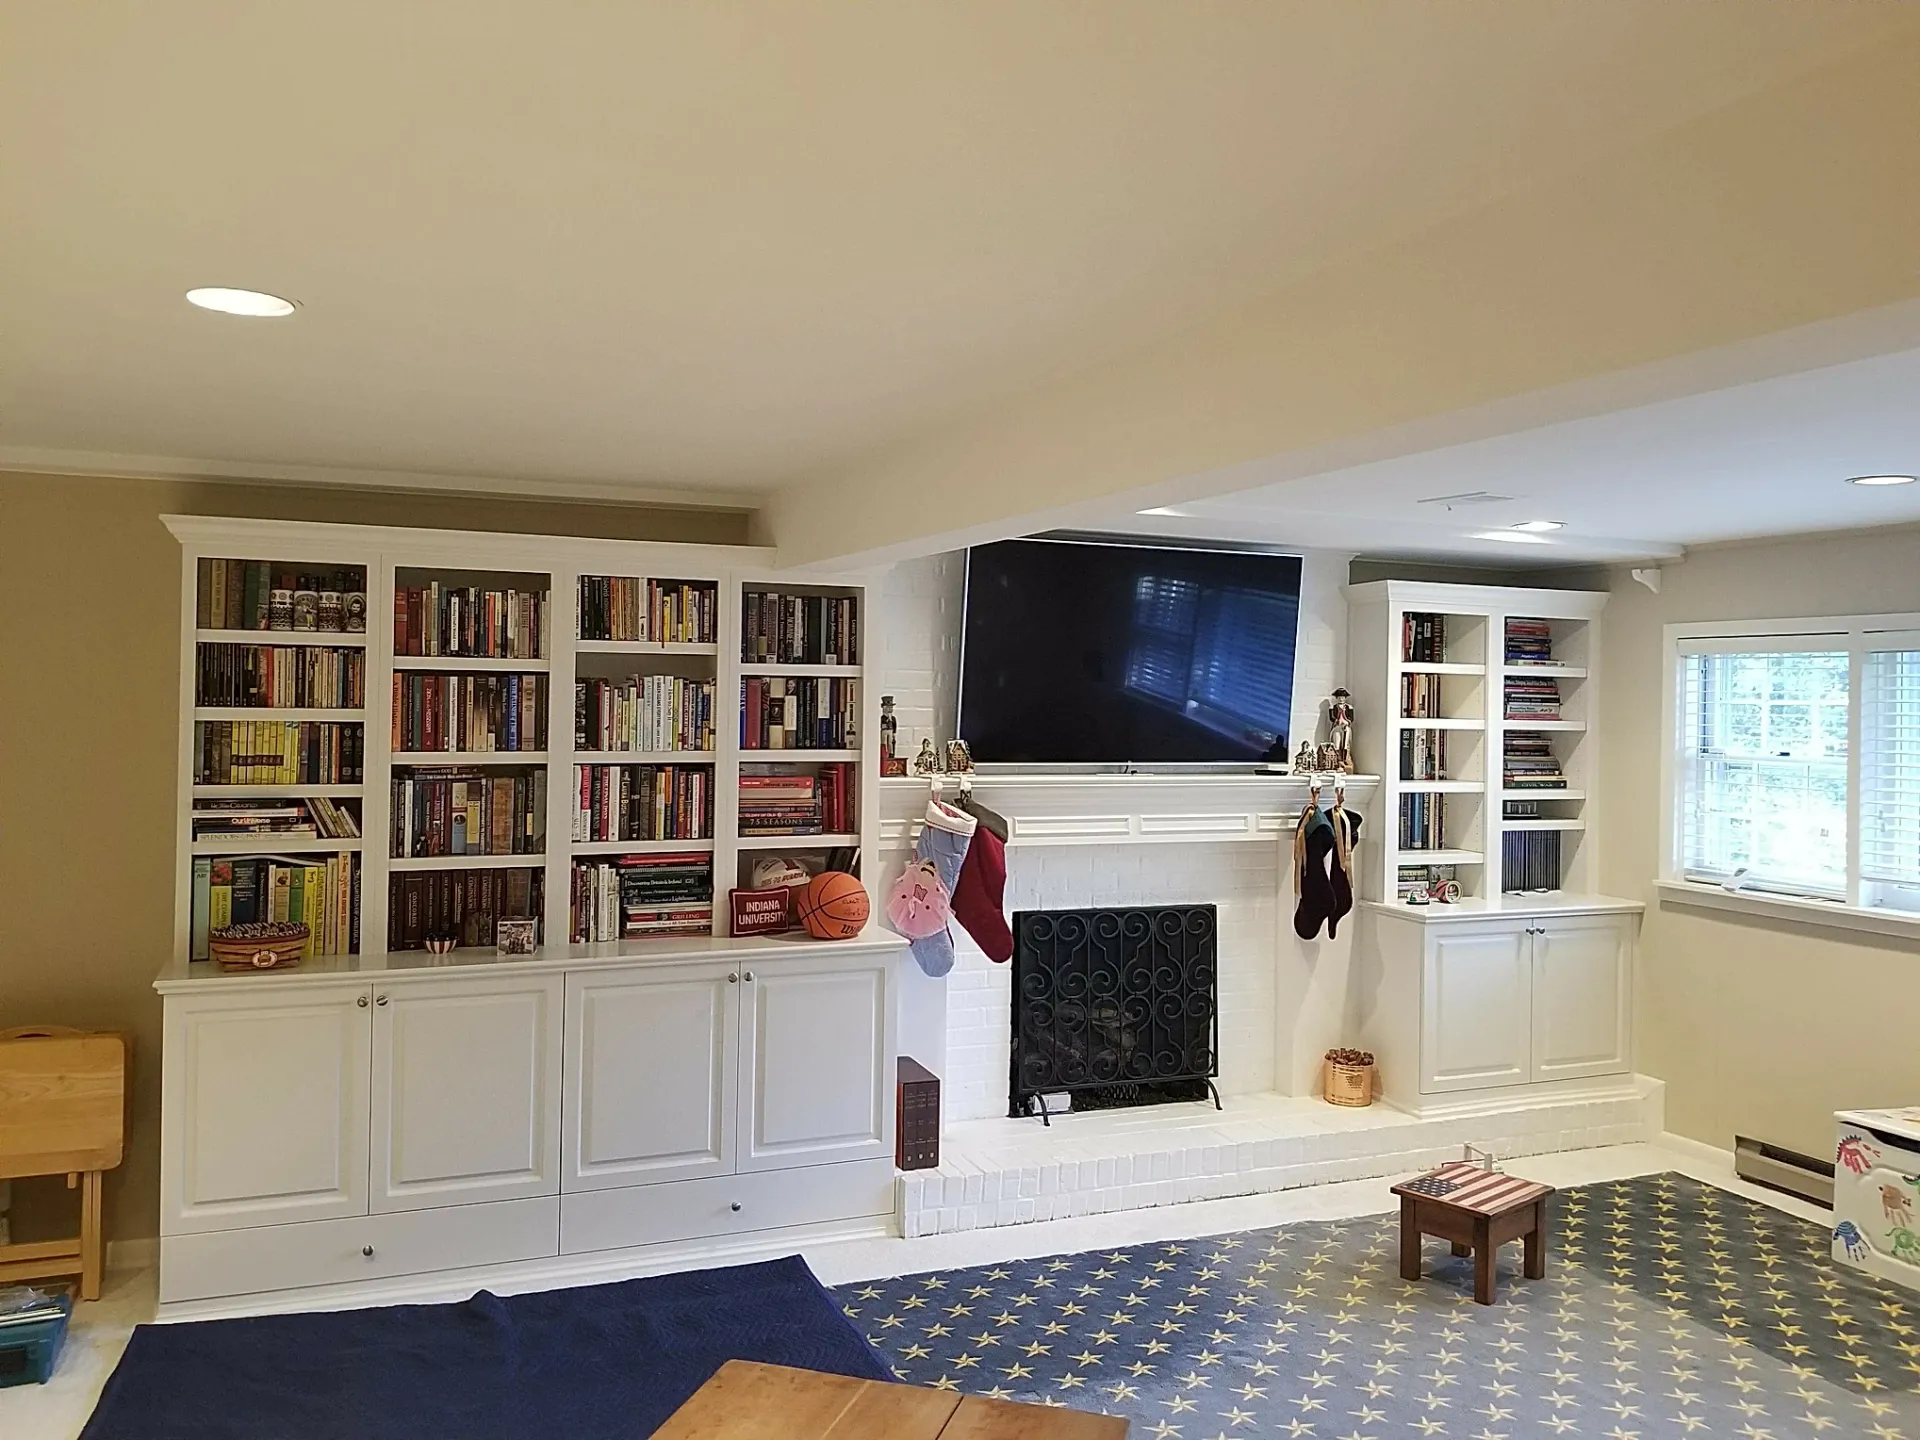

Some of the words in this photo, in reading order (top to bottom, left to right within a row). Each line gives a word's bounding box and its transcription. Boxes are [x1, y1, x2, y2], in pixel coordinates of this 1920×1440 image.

[621, 781, 629, 799] LAURA
[621, 799, 629, 814] BUSH
[746, 900, 780, 912] INDIANA
[738, 911, 787, 925] UNIVERSITY
